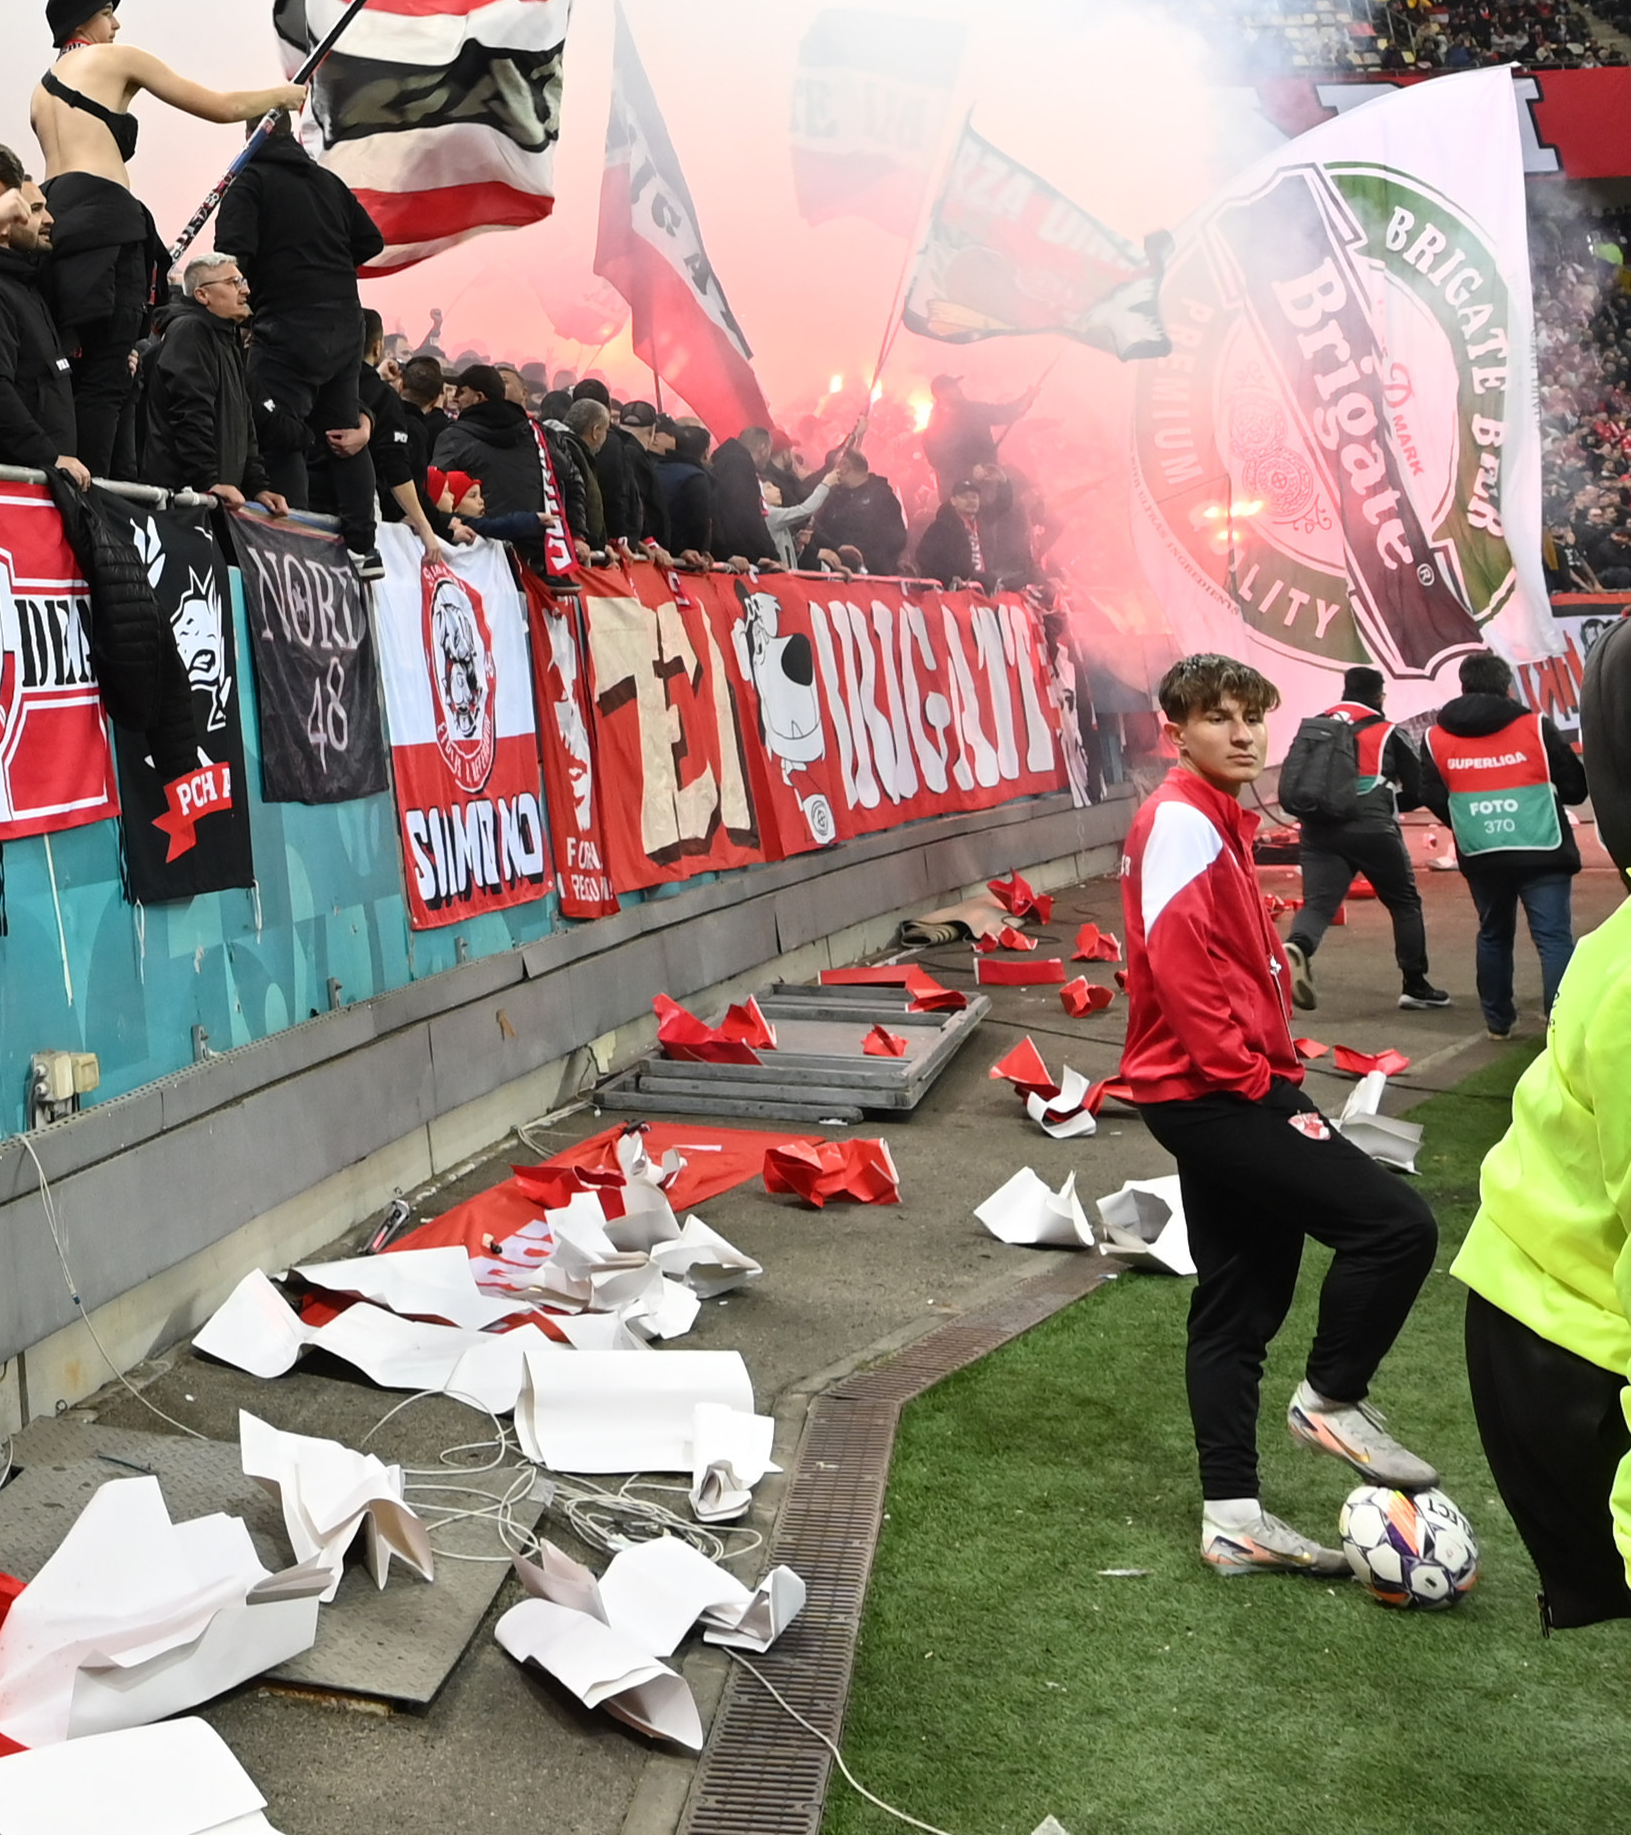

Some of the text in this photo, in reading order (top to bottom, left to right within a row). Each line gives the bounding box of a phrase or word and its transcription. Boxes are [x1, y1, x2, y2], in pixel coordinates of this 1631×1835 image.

[1386, 205, 1509, 395] BRIGATE
[1150, 297, 1216, 486] PREMIUM
[1271, 256, 1414, 570] Brigate
[1393, 414, 1425, 478] MARK
[307, 656, 349, 775] 48
[1446, 750, 1528, 771] SUPERLIGA
[176, 769, 218, 817] PCH
[1468, 798, 1520, 817] FOTO
[1483, 818, 1516, 835] 370
